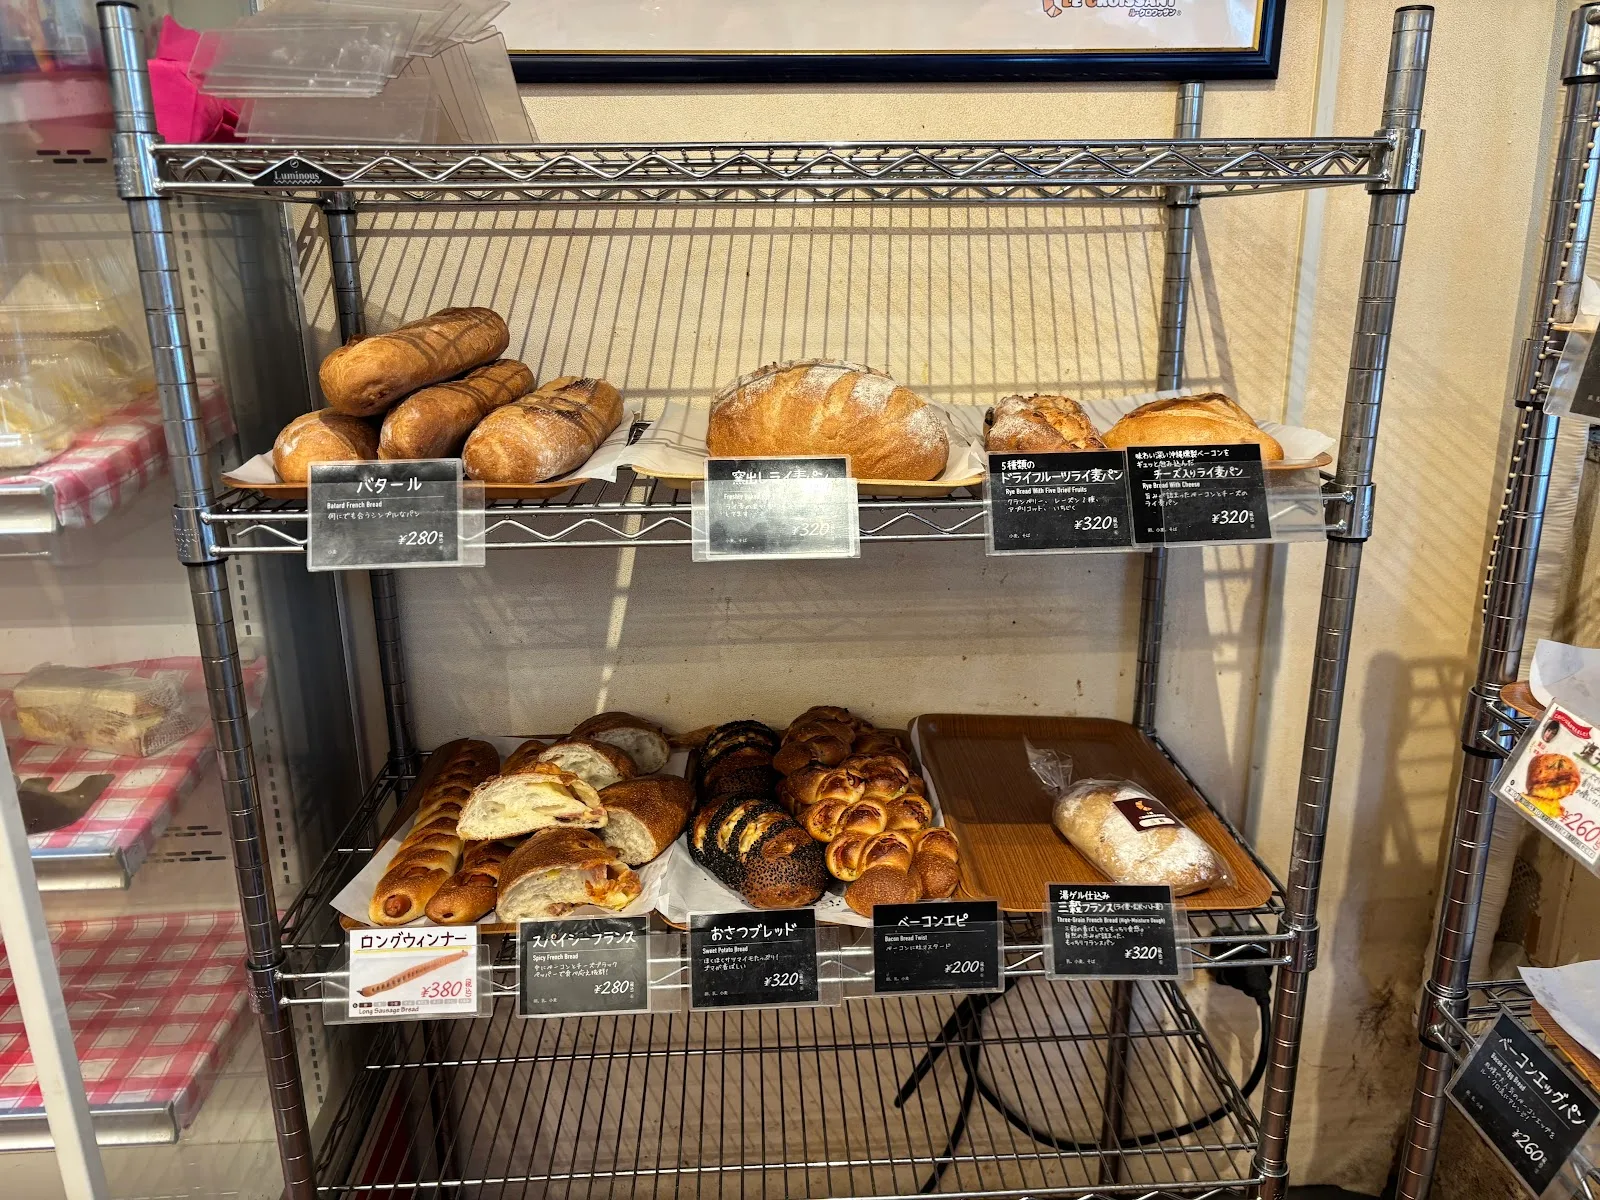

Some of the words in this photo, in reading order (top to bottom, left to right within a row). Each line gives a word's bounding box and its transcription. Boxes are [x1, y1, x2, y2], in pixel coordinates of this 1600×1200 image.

[274, 171, 320, 180] Luminous
[1001, 459, 1035, 471] 5種類の
[1136, 459, 1194, 469] ギュッと包み込んだ
[1001, 468, 1124, 484] ドライフルーツライ麦パン
[1153, 465, 1244, 480] チーズ入りライ麦パン
[356, 476, 423, 494] バタール
[1005, 488, 1015, 496] Rye
[1057, 486, 1071, 494] Dried
[1142, 482, 1152, 490] Rye
[326, 502, 345, 510] Batard
[346, 501, 365, 509] French
[366, 500, 383, 508] Bread
[328, 510, 420, 520] 何にでも合うシンプルなパン
[1212, 509, 1249, 525] ¥320
[1074, 515, 1113, 531] ¥320
[398, 530, 439, 546] ¥280
[1059, 889, 1110, 901] 湯ゲル仕込み
[897, 912, 969, 928] ベーコンエピ
[1150, 917, 1166, 925] Dough)
[710, 922, 798, 941] おさつブレッド
[361, 931, 467, 949] ロングウィンナー
[532, 930, 636, 949] スパイシーフランス
[532, 954, 546, 962] Spicy
[546, 953, 564, 961] French
[702, 947, 717, 955] Sweet
[718, 946, 733, 954] Potato
[733, 945, 749, 953] Bread
[1124, 946, 1158, 960] ¥320
[944, 960, 980, 974] ¥200
[763, 972, 799, 987] ¥320
[420, 981, 463, 998] ¥380
[594, 980, 629, 995] ¥280
[374, 1007, 400, 1015] Sausage
[1490, 1052, 1504, 1068] Bacon
[1506, 1069, 1515, 1082] Egg
[1512, 1076, 1526, 1092] Bread
[1499, 1037, 1586, 1125] ベーコンエッグパン
[1512, 1128, 1544, 1162] ¥260
